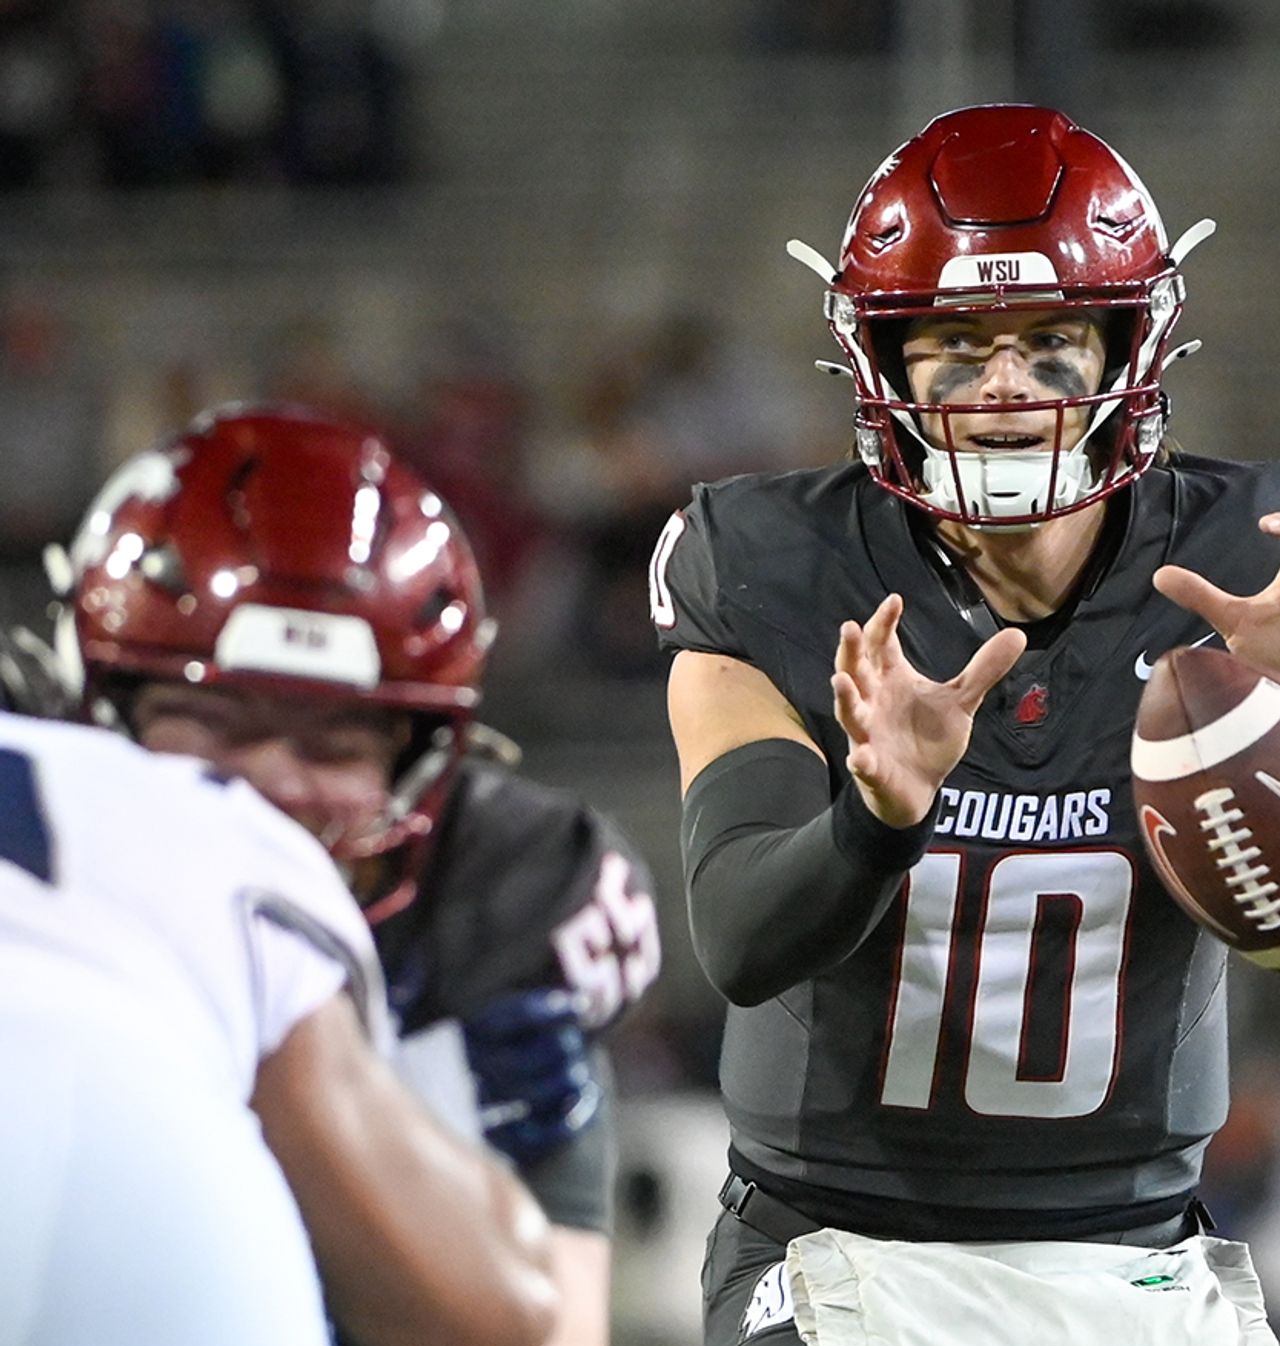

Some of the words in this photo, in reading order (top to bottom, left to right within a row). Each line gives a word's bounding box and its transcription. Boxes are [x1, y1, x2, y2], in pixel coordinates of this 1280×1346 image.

[976, 259, 1020, 283] WSU
[933, 786, 1112, 841] COUGARS
[879, 850, 1136, 1119] 10
